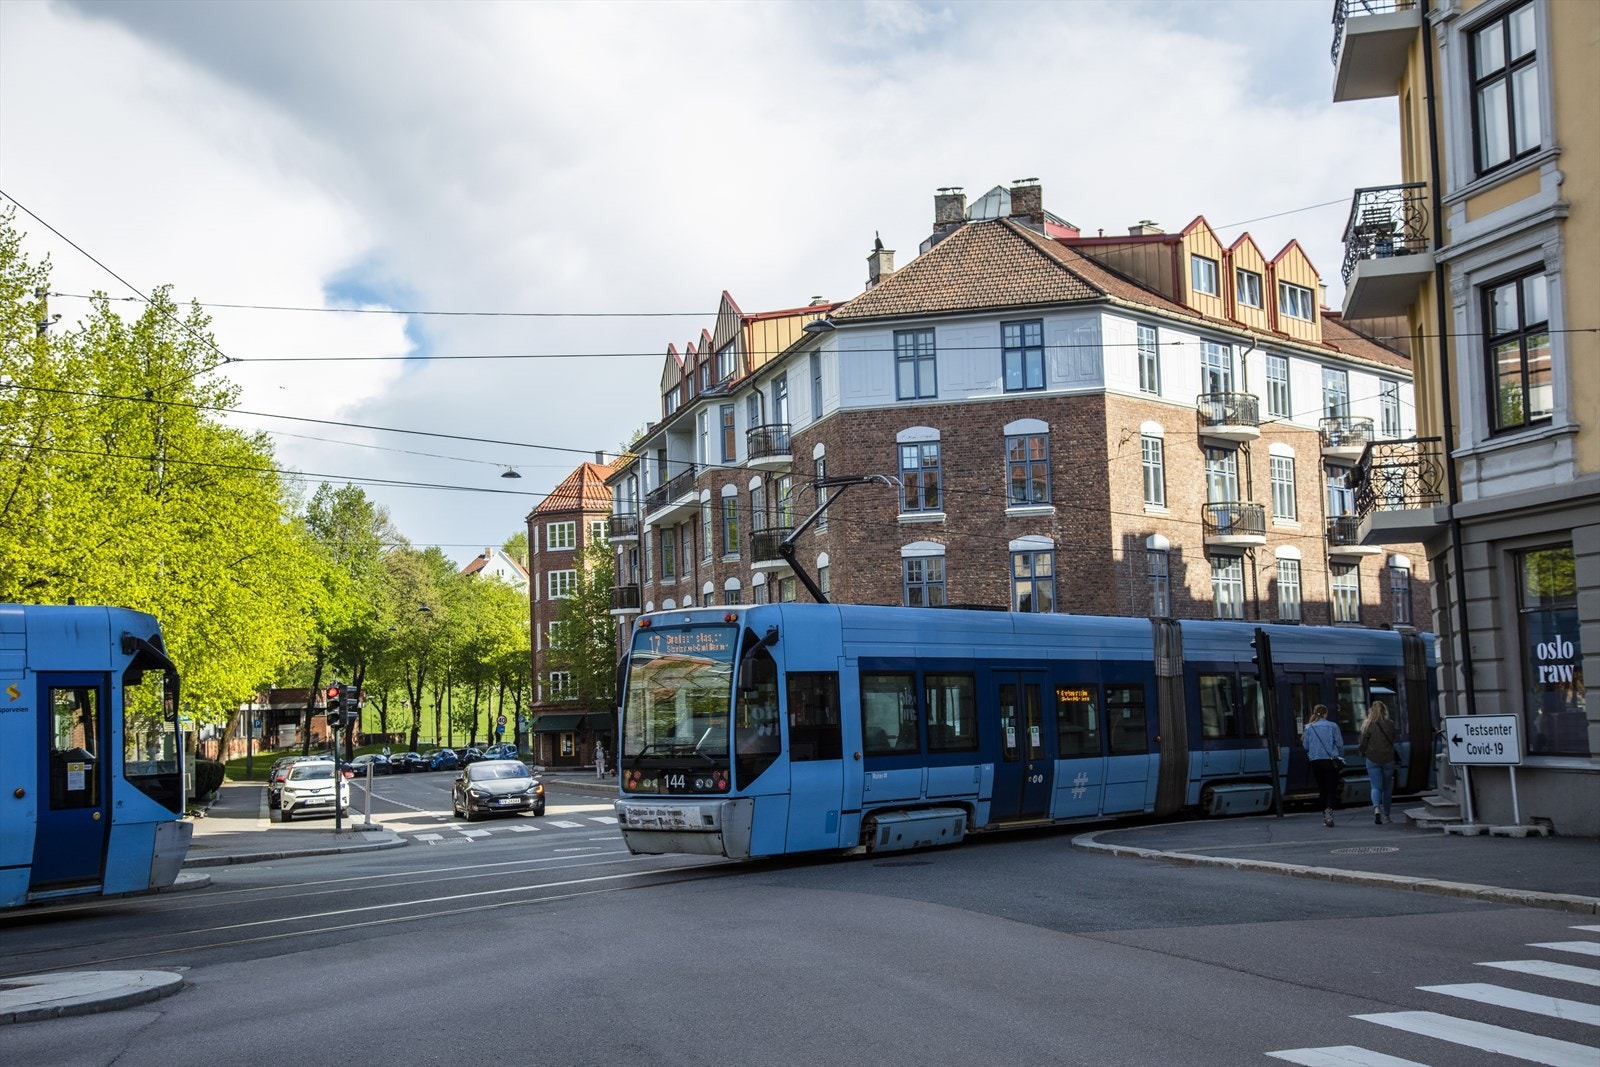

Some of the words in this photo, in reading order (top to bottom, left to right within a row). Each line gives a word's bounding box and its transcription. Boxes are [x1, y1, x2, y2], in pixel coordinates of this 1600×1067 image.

[1537, 634, 1574, 660] oslo
[1538, 664, 1575, 683] raw
[1464, 724, 1512, 736] Testsenter
[1466, 742, 1503, 755] Covid-19
[664, 774, 686, 788] 144
